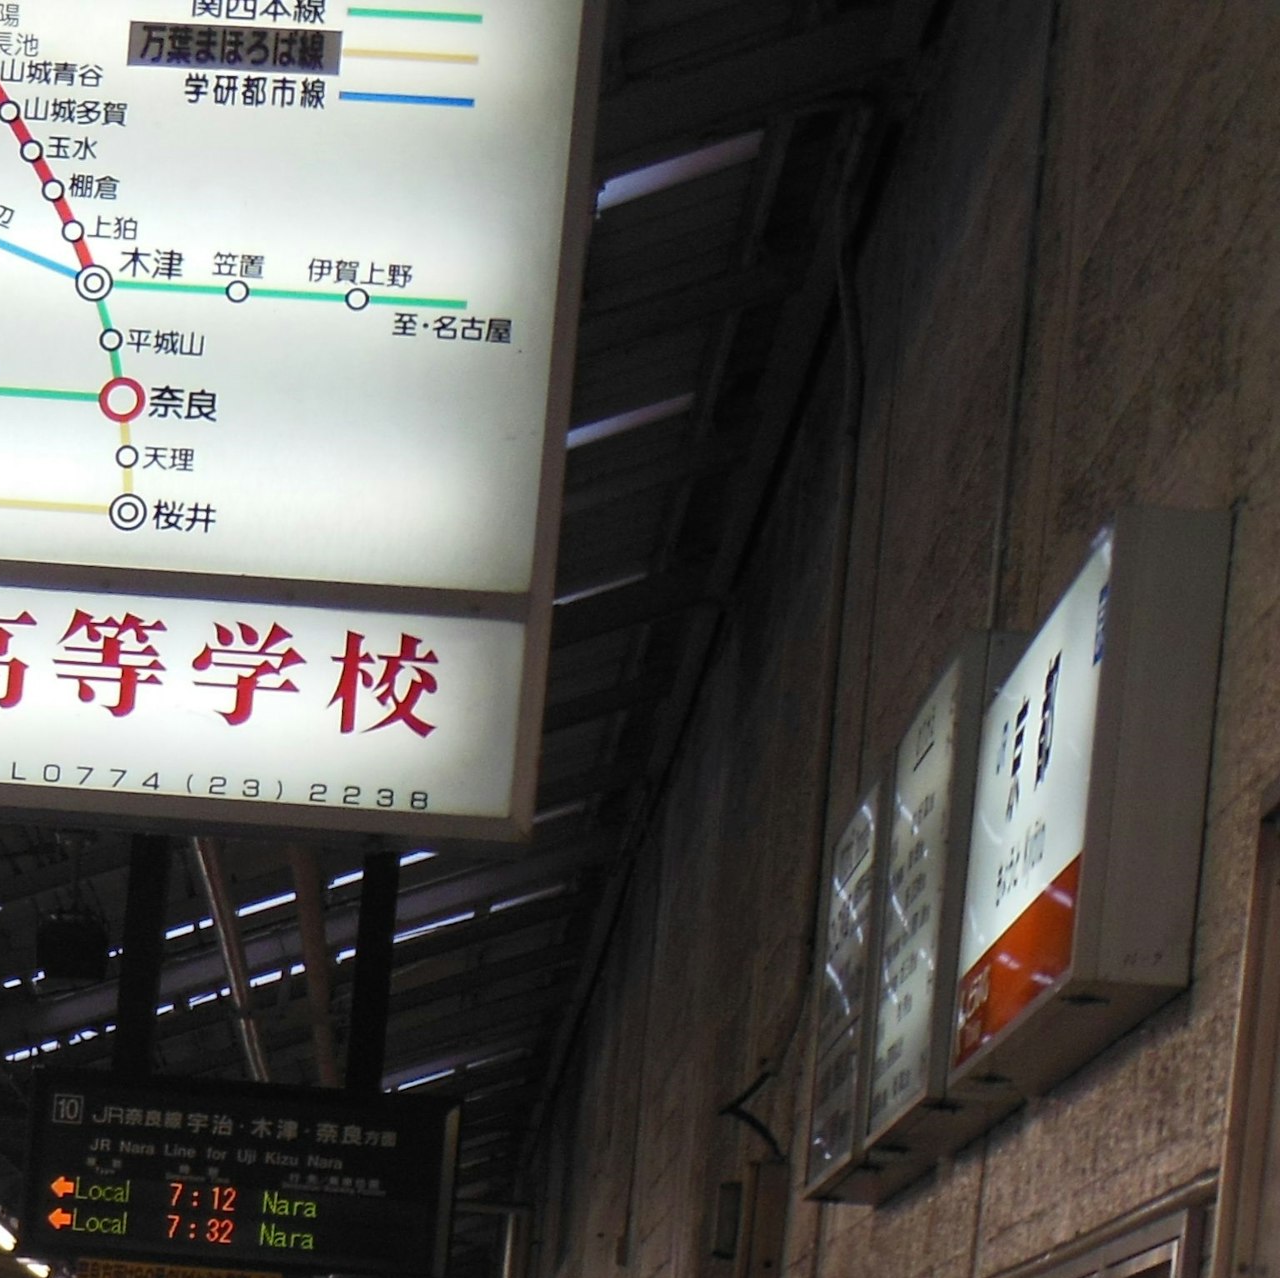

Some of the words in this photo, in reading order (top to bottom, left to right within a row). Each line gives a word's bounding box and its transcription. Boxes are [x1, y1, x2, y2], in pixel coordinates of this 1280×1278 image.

[140, 26, 325, 69] 万葉まほろば線
[0, 61, 104, 88] 山城青谷
[184, 73, 326, 109] 学研都市線
[23, 97, 127, 128] 山城多賀
[46, 135, 98, 161] 玉水
[68, 173, 120, 201] 棚倉
[86, 215, 139, 241] 上狛
[120, 249, 185, 279] 木津
[212, 251, 264, 279] 笠置
[308, 257, 413, 289] 伊賀上野
[126, 329, 205, 357] 平城山
[392, 312, 512, 344] 至・名古屋
[148, 386, 218, 422] 奈良
[142, 446, 195, 472] 天理
[152, 501, 217, 534] 桜井
[56, 1097, 80, 1122] 10
[89, 1137, 112, 1153] JR
[119, 1139, 155, 1156] Nara
[164, 1142, 196, 1159] Line
[206, 1145, 228, 1161] for
[236, 1148, 258, 1166] Uji
[265, 1150, 299, 1168] Kizu
[307, 1153, 344, 1170] Nara
[75, 1176, 130, 1203] Local
[168, 1182, 238, 1213] 7:12
[262, 1191, 317, 1218] Nara
[72, 1209, 127, 1236] Local
[165, 1214, 235, 1244] 7:32
[259, 1223, 315, 1250] Nara
